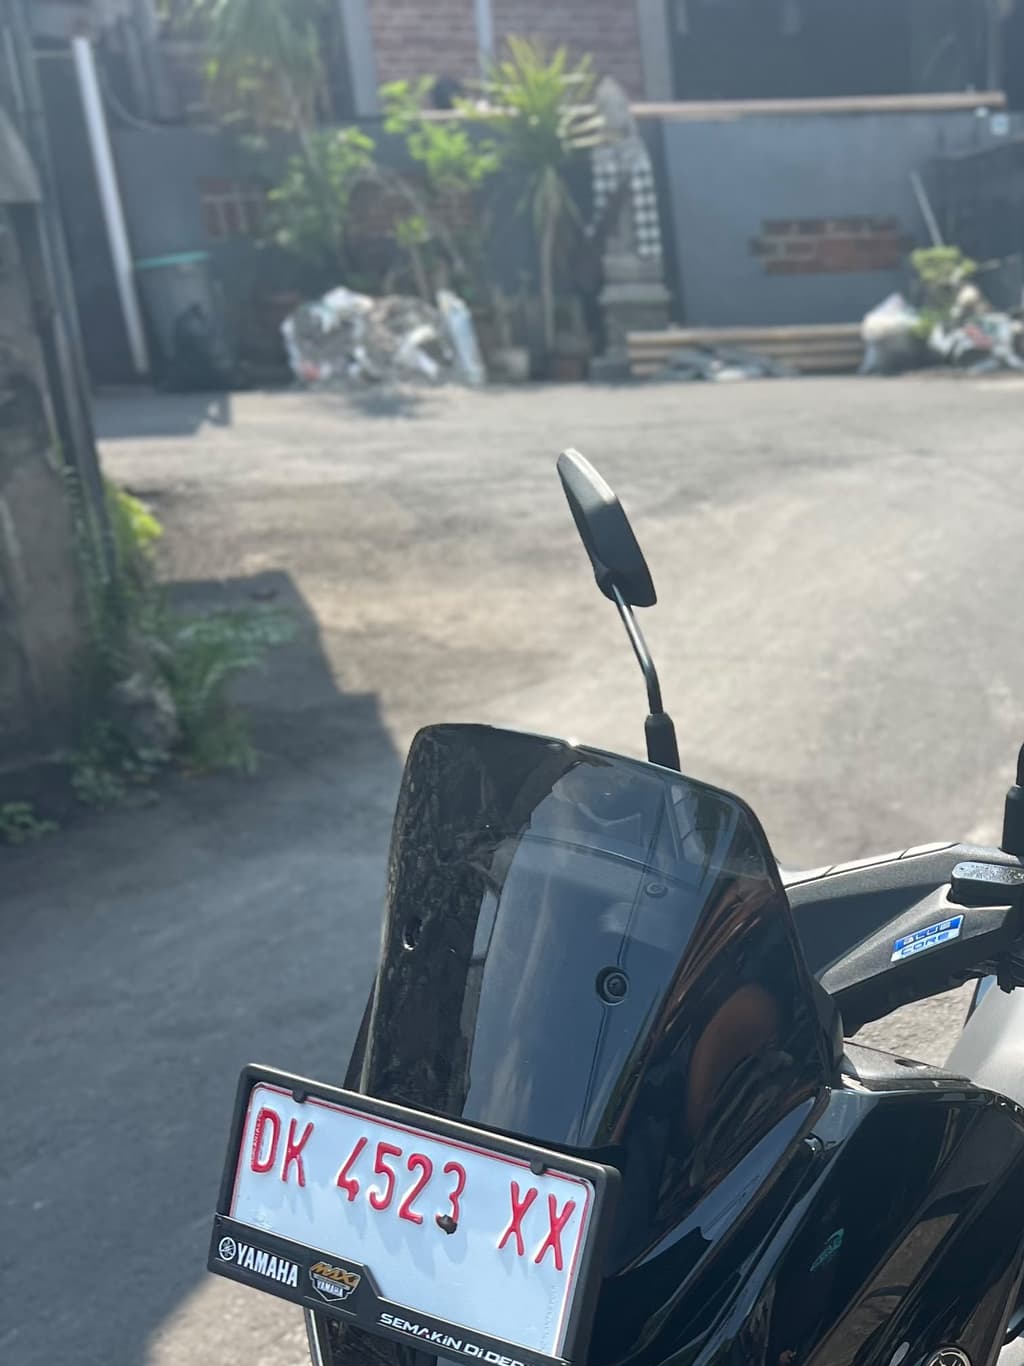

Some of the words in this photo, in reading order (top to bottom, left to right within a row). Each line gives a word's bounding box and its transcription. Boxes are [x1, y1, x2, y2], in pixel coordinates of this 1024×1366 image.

[900, 931, 950, 956] CORE
[903, 921, 951, 945] BLUE
[250, 1106, 315, 1187] DK
[336, 1137, 467, 1234] 4523
[497, 1180, 576, 1271] XX
[236, 1242, 299, 1288] YAMAHA
[316, 1279, 344, 1298] YAMAHA
